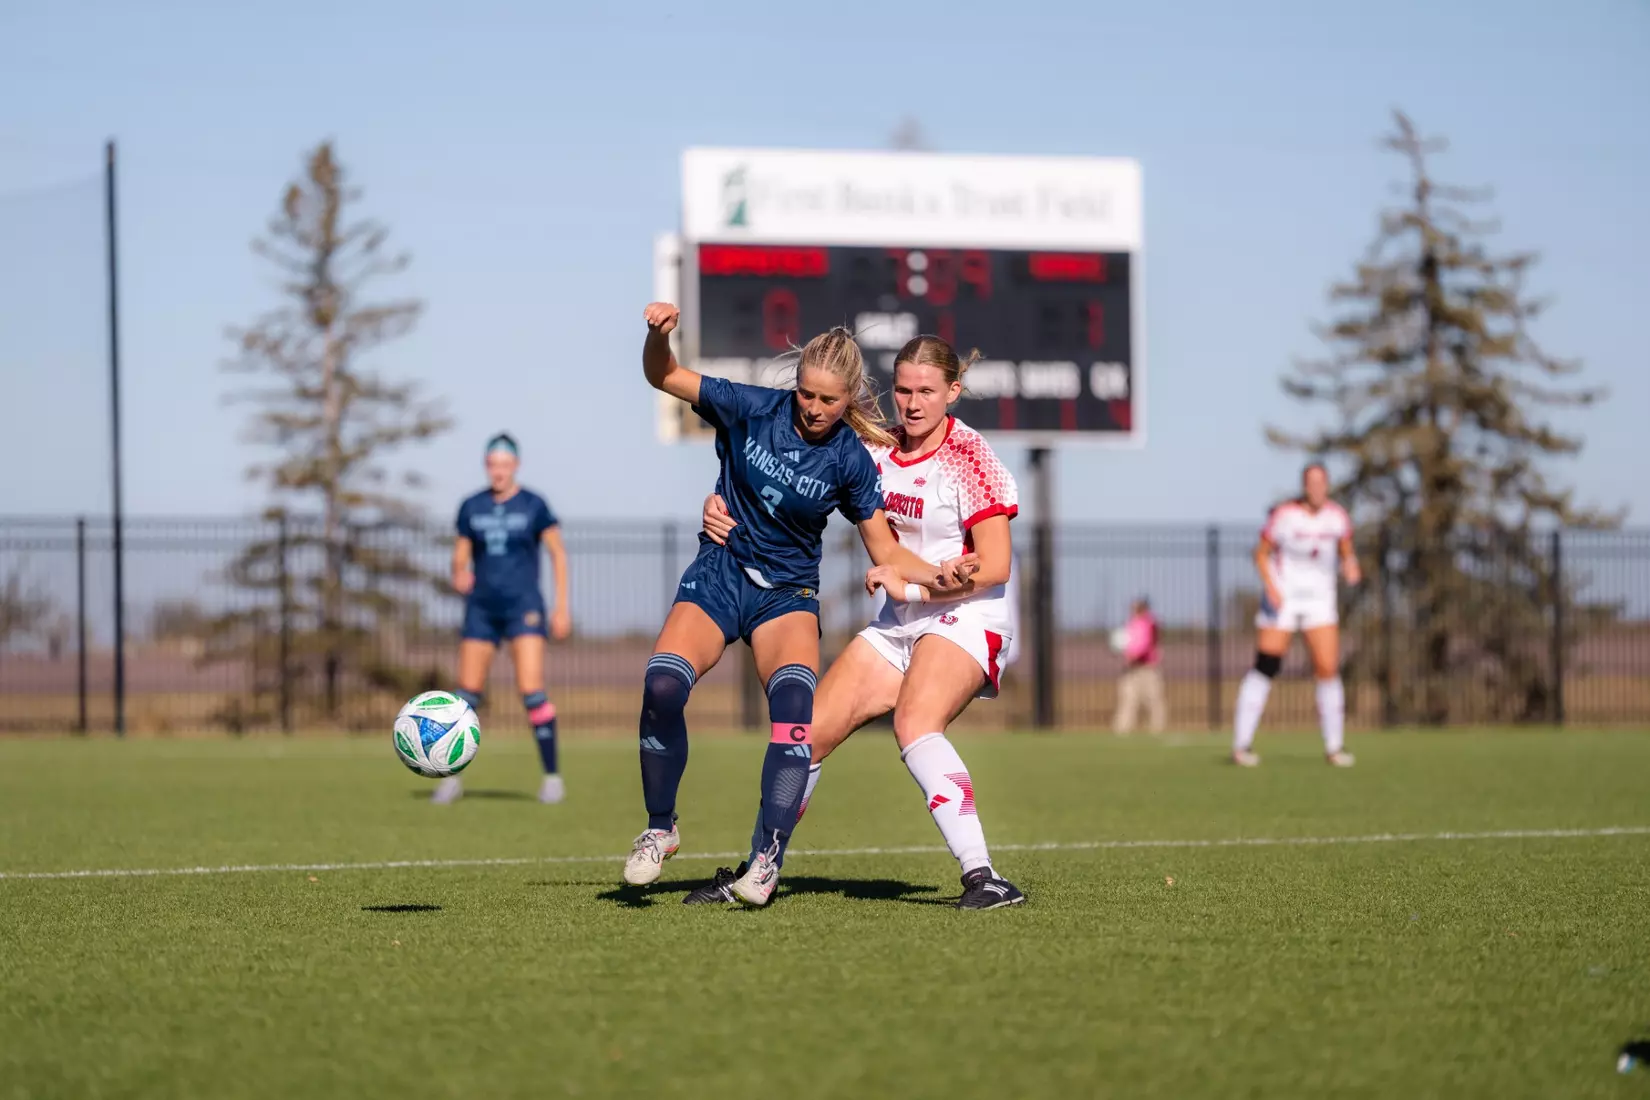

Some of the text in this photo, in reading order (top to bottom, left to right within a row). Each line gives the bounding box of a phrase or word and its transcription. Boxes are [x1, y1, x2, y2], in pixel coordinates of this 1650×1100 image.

[743, 436, 830, 500] KANSAS CITY
[789, 725, 806, 742] C
